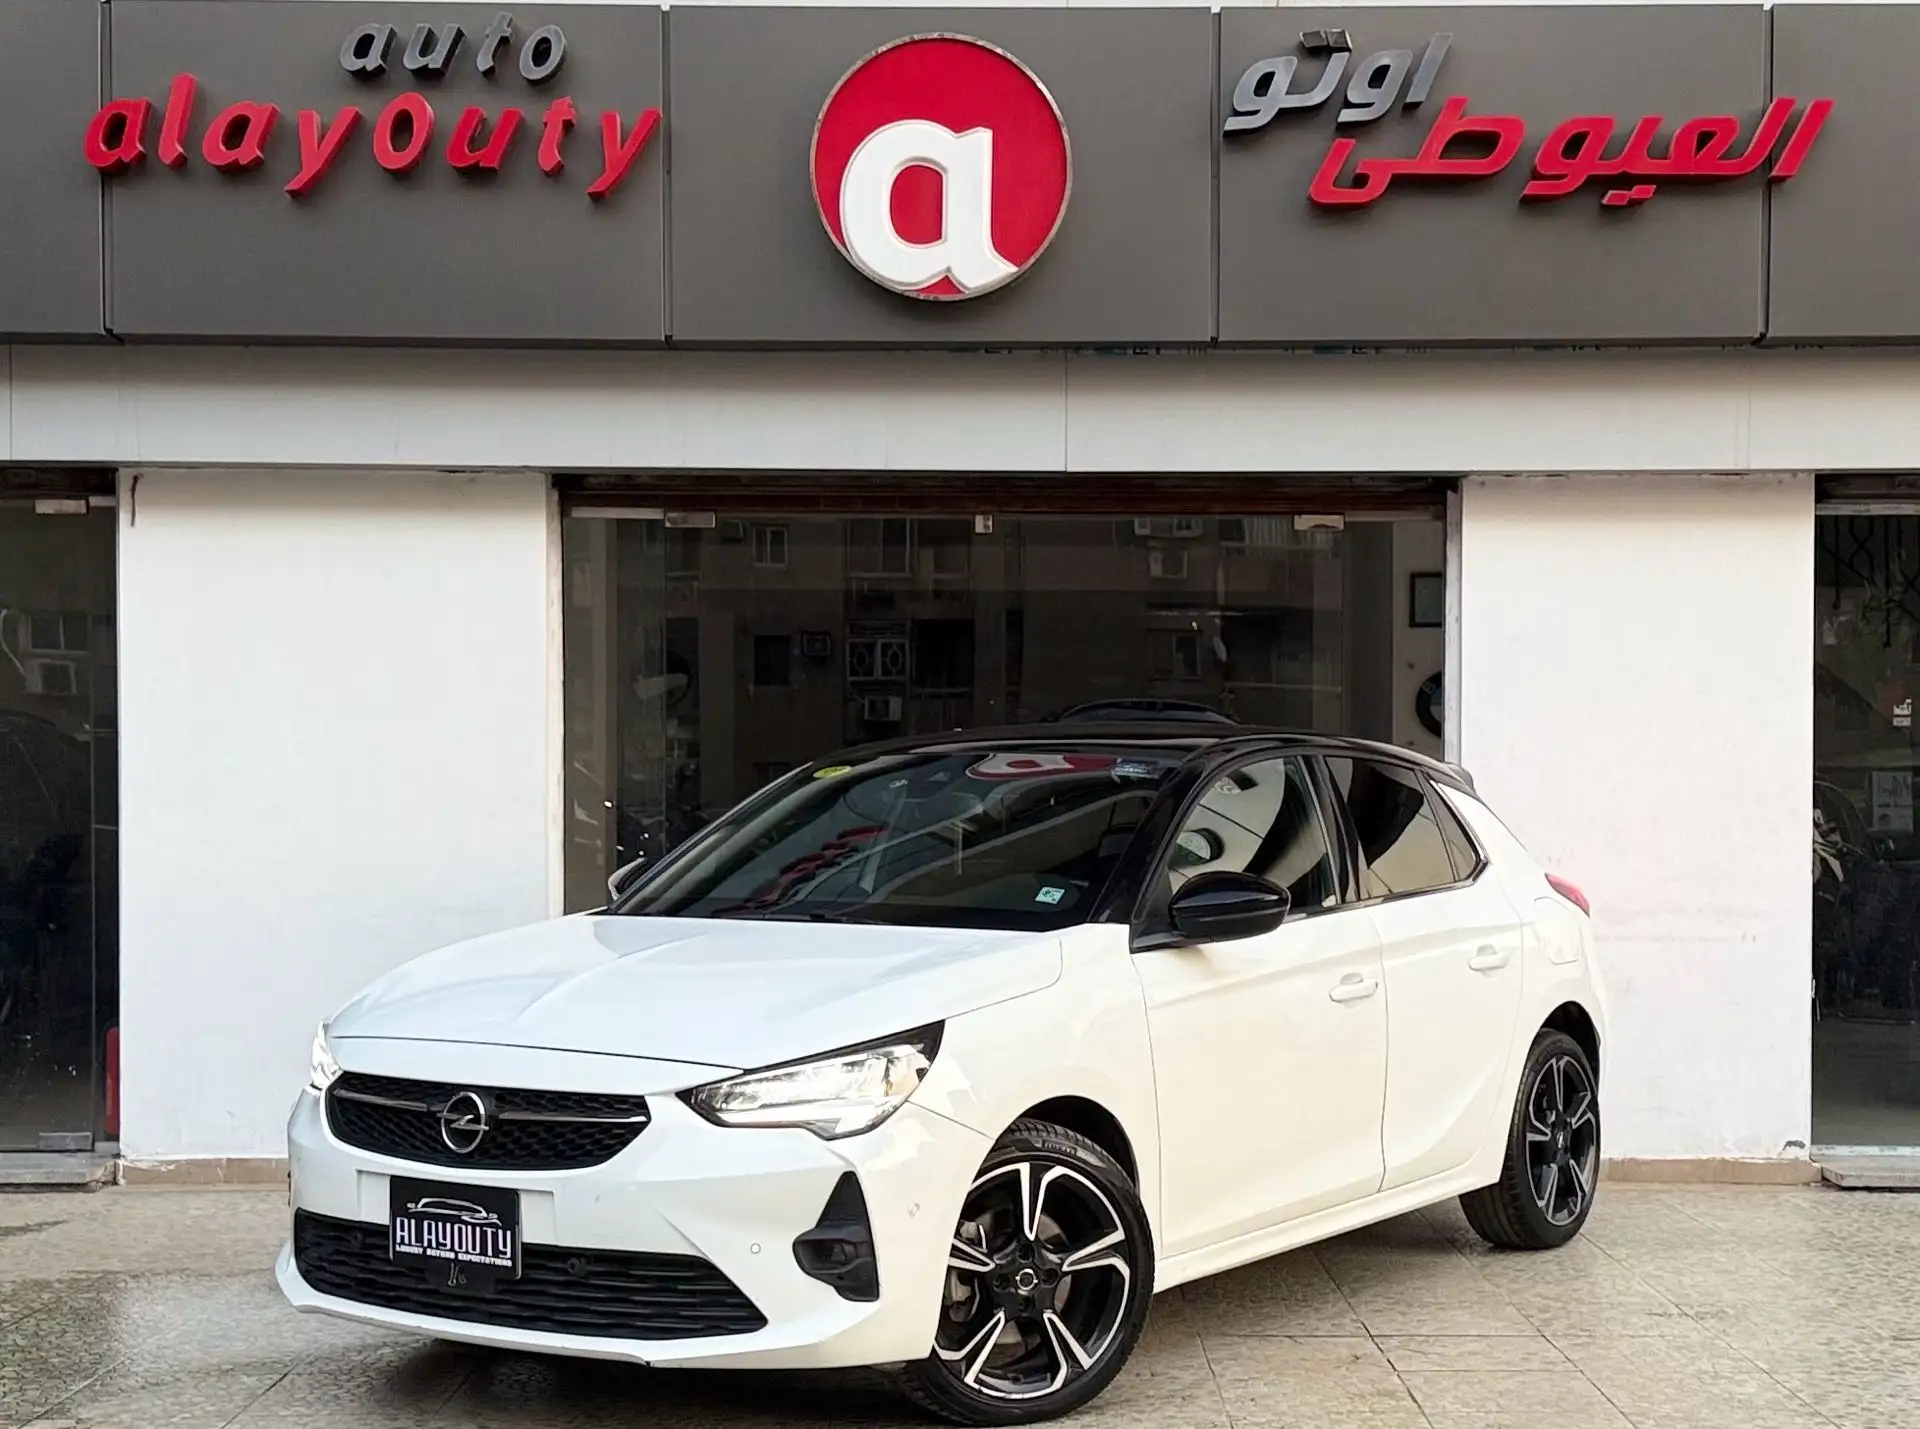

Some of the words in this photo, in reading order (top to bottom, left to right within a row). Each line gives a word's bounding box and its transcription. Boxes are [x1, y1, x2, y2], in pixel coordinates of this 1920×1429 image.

[340, 13, 567, 82] auto
[1223, 28, 1452, 134] اوتو
[839, 118, 1020, 293] a
[395, 1216, 512, 1259] ALAYOUTY
